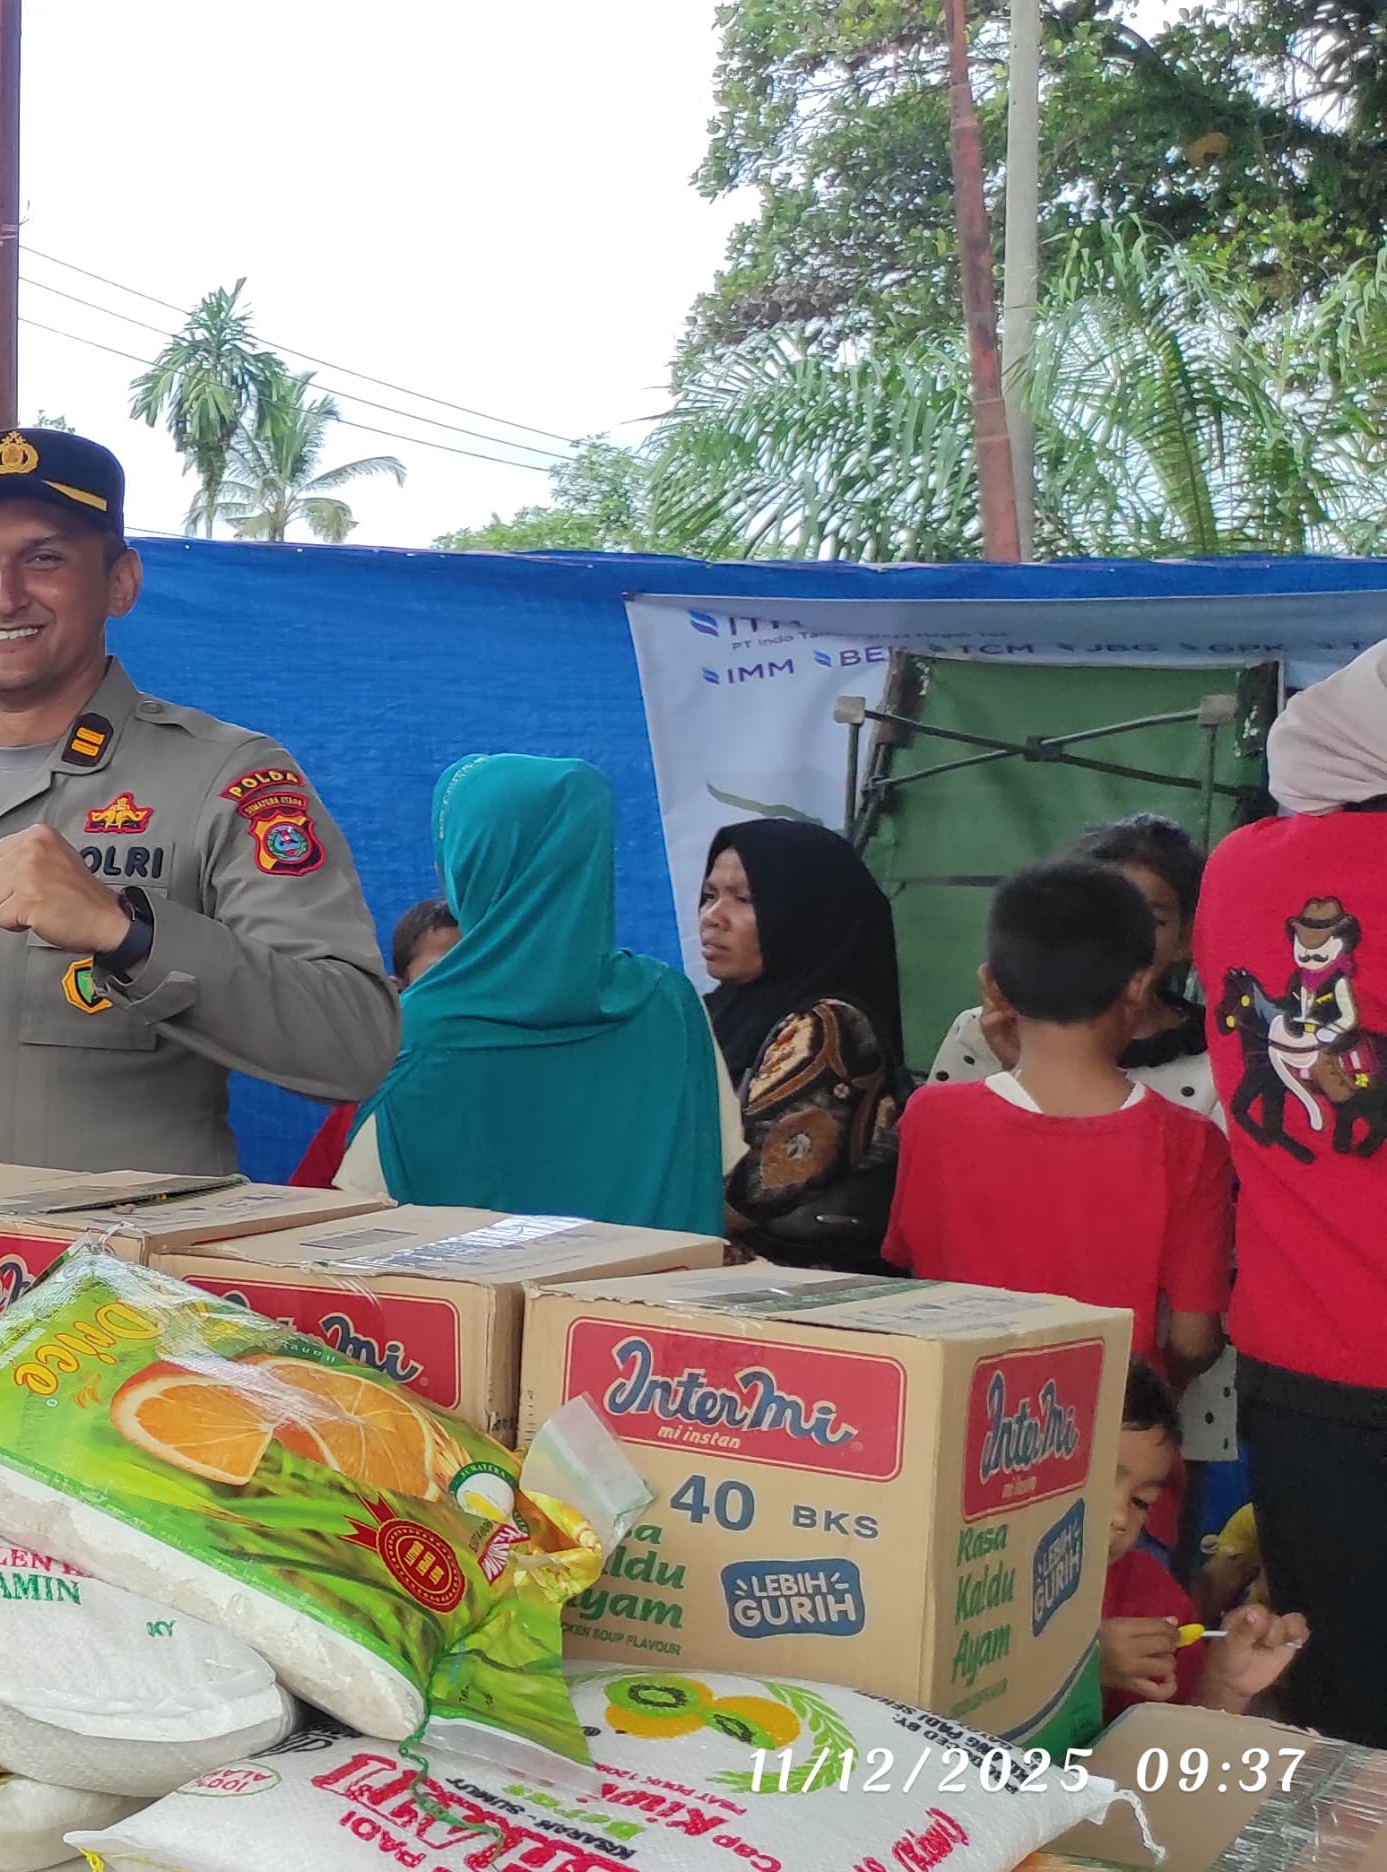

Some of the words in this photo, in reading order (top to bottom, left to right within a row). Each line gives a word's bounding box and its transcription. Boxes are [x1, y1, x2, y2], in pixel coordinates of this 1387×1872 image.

[728, 659, 794, 684] IMM
[228, 770, 299, 798] POLDA
[80, 845, 164, 879] OLRI
[657, 1424, 683, 1443] mi
[683, 1427, 741, 1450] instan
[670, 1475, 756, 1532] 40
[792, 1503, 880, 1540] BKS
[957, 1523, 1010, 1567] Rasa
[750, 1573, 830, 1598] LEBIH
[954, 1559, 1016, 1625] Kaldu
[732, 1594, 859, 1627] GURIH
[592, 1628, 625, 1643] SOUP
[627, 1634, 682, 1656] FLAVOUR
[951, 1623, 1011, 1687] Ayam
[712, 1833, 782, 1872] Cap
